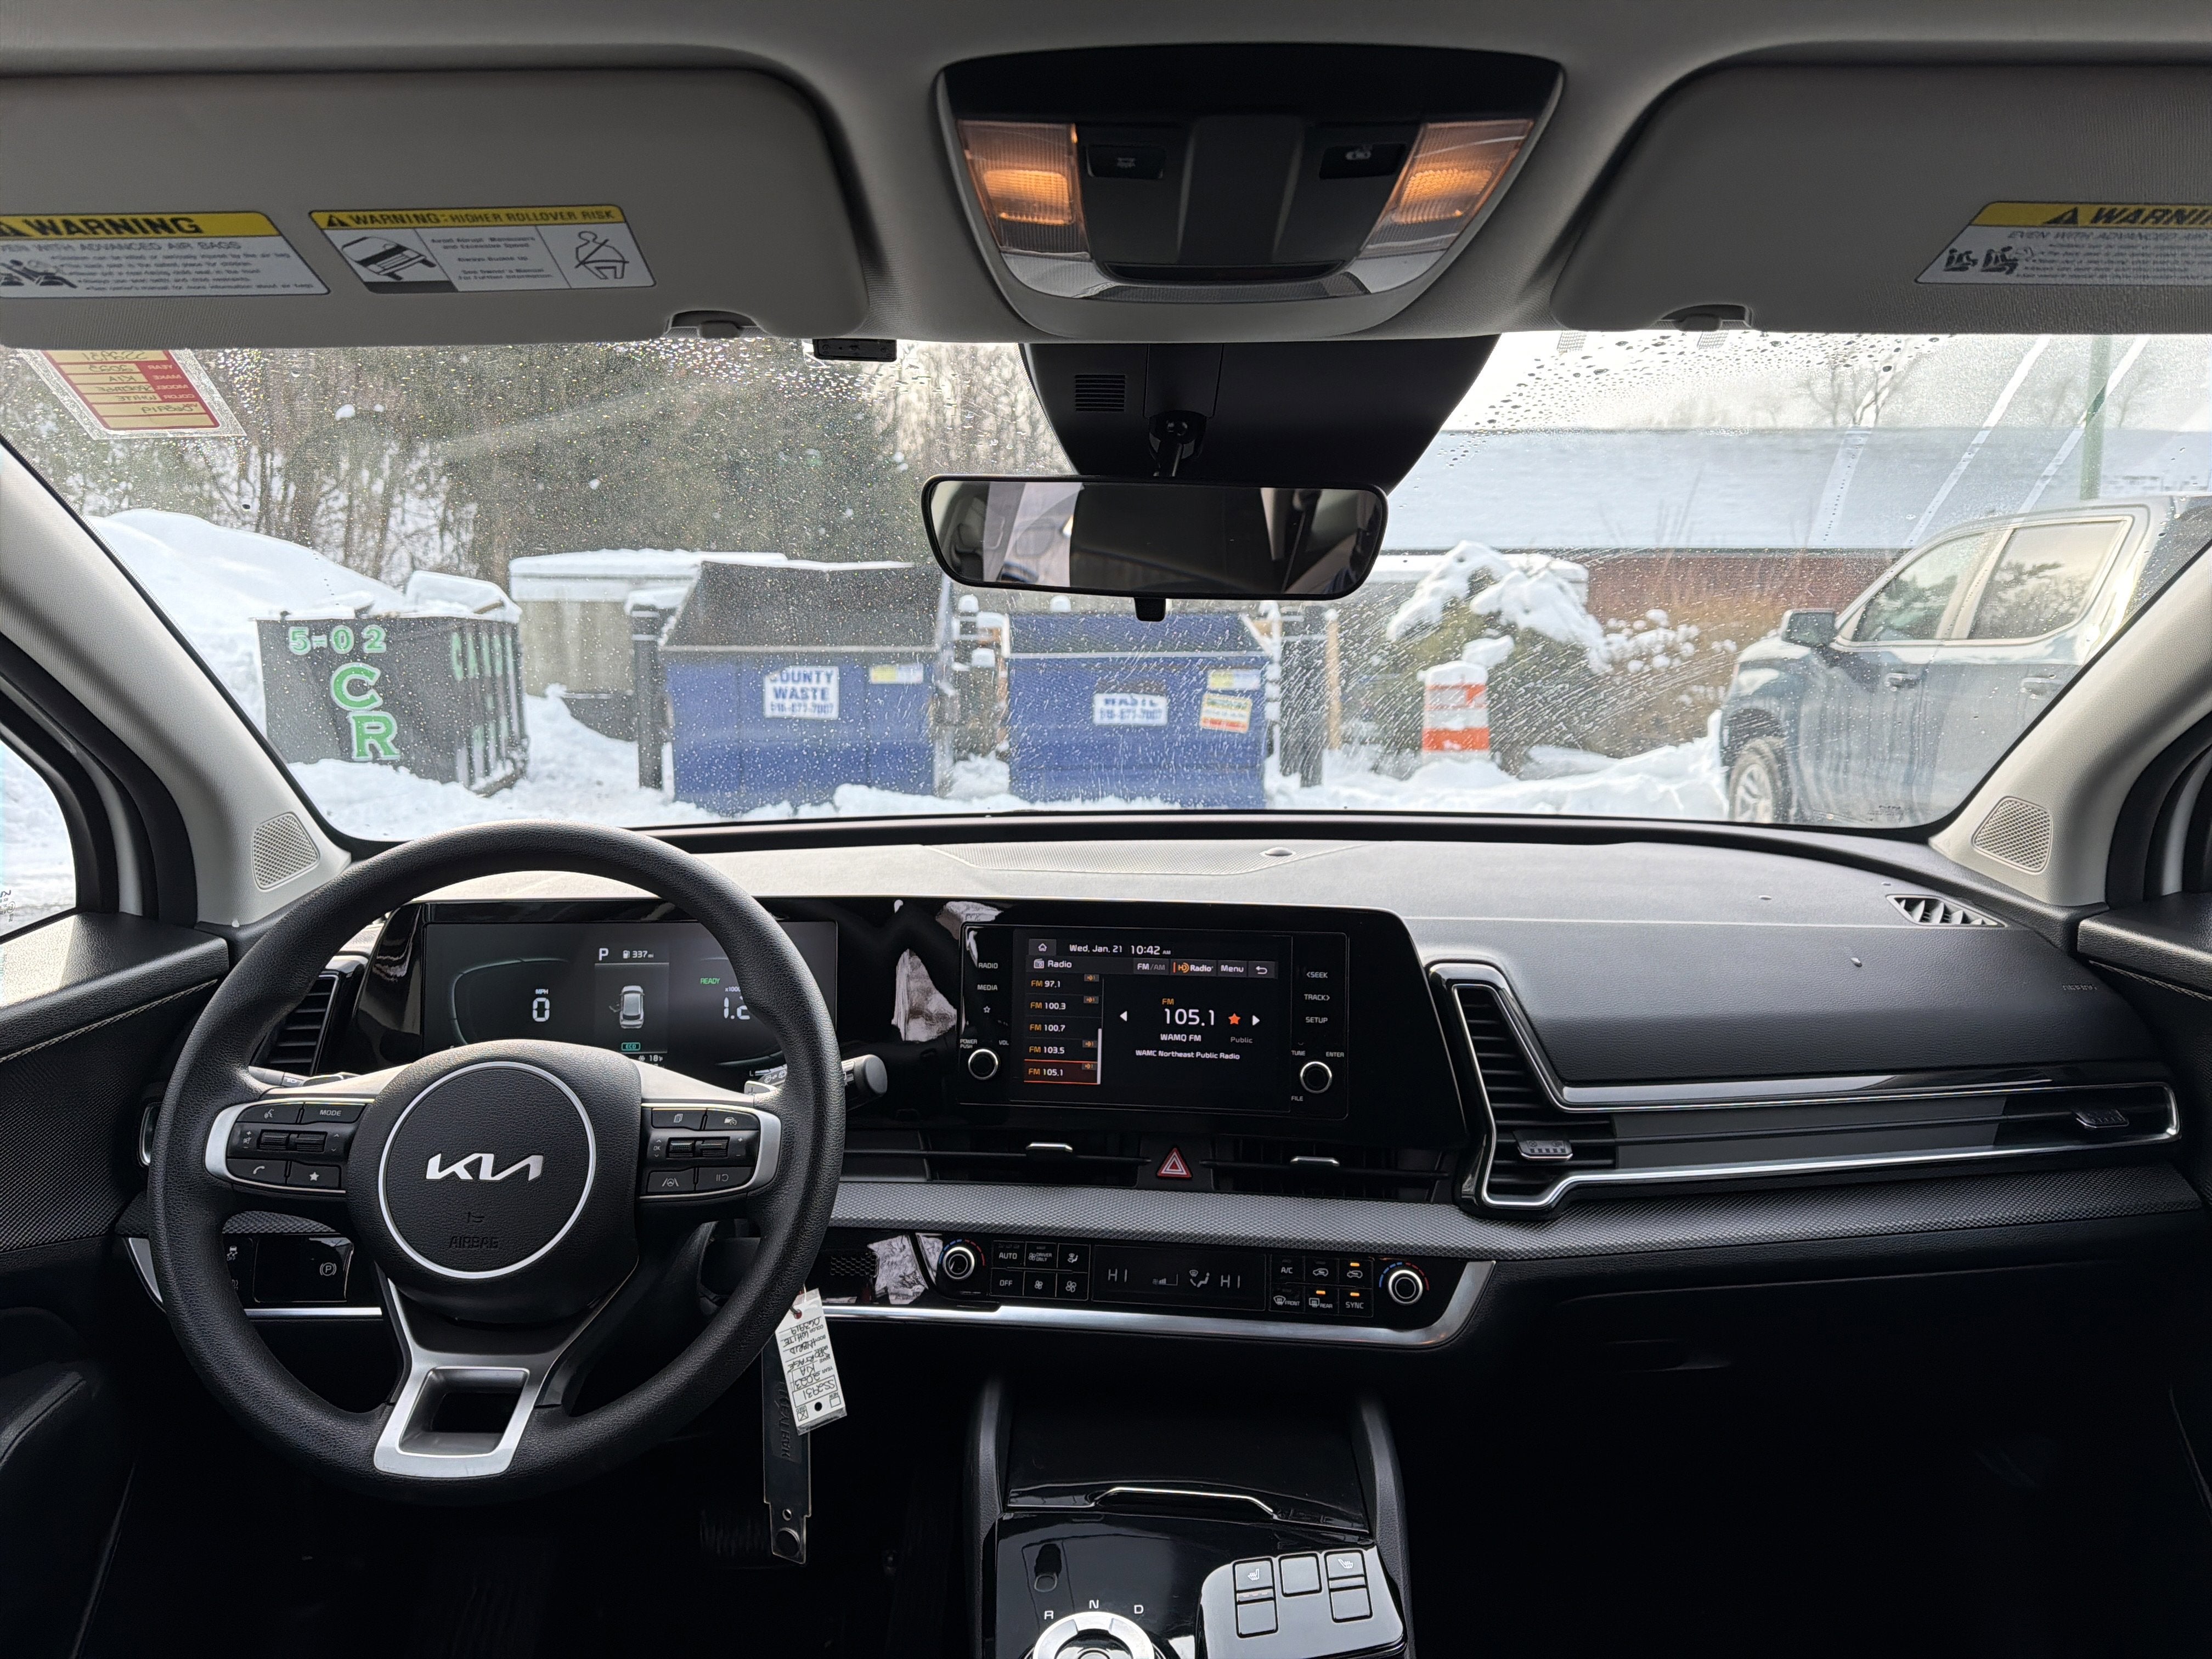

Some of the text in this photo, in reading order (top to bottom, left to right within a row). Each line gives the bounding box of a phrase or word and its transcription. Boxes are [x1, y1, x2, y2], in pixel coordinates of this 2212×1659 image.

[450, 211, 502, 222] HIGHER
[510, 210, 576, 221] ROLLOVER
[581, 208, 615, 219] RISK
[24, 216, 203, 237] WARNING
[770, 670, 834, 684] OUNTY
[330, 662, 383, 711] C
[773, 686, 831, 701] WASTE
[349, 711, 401, 761] R
[599, 947, 609, 961] P
[1092, 945, 1110, 953] Jan.
[1130, 945, 1161, 955] 10:42
[1047, 960, 1072, 969] Radio
[1221, 964, 1244, 973] Menu
[532, 997, 550, 1022] 0
[1164, 1008, 1215, 1027] 105.1
[1043, 1046, 1065, 1054] 103.5
[1159, 1050, 1194, 1058] Northeast
[998, 1252, 1018, 1260] AUTO
[791, 1317, 820, 1335] 063919
[809, 1324, 824, 1333] COLOR
[782, 1330, 809, 1347] WHITE
[800, 1363, 816, 1376] KIA
[794, 1372, 821, 1389] 2023
[803, 1379, 836, 1400] SS2931
[1088, 1599, 1099, 1610] N
[1133, 1604, 1144, 1615] D
[1043, 1610, 1054, 1620] R
